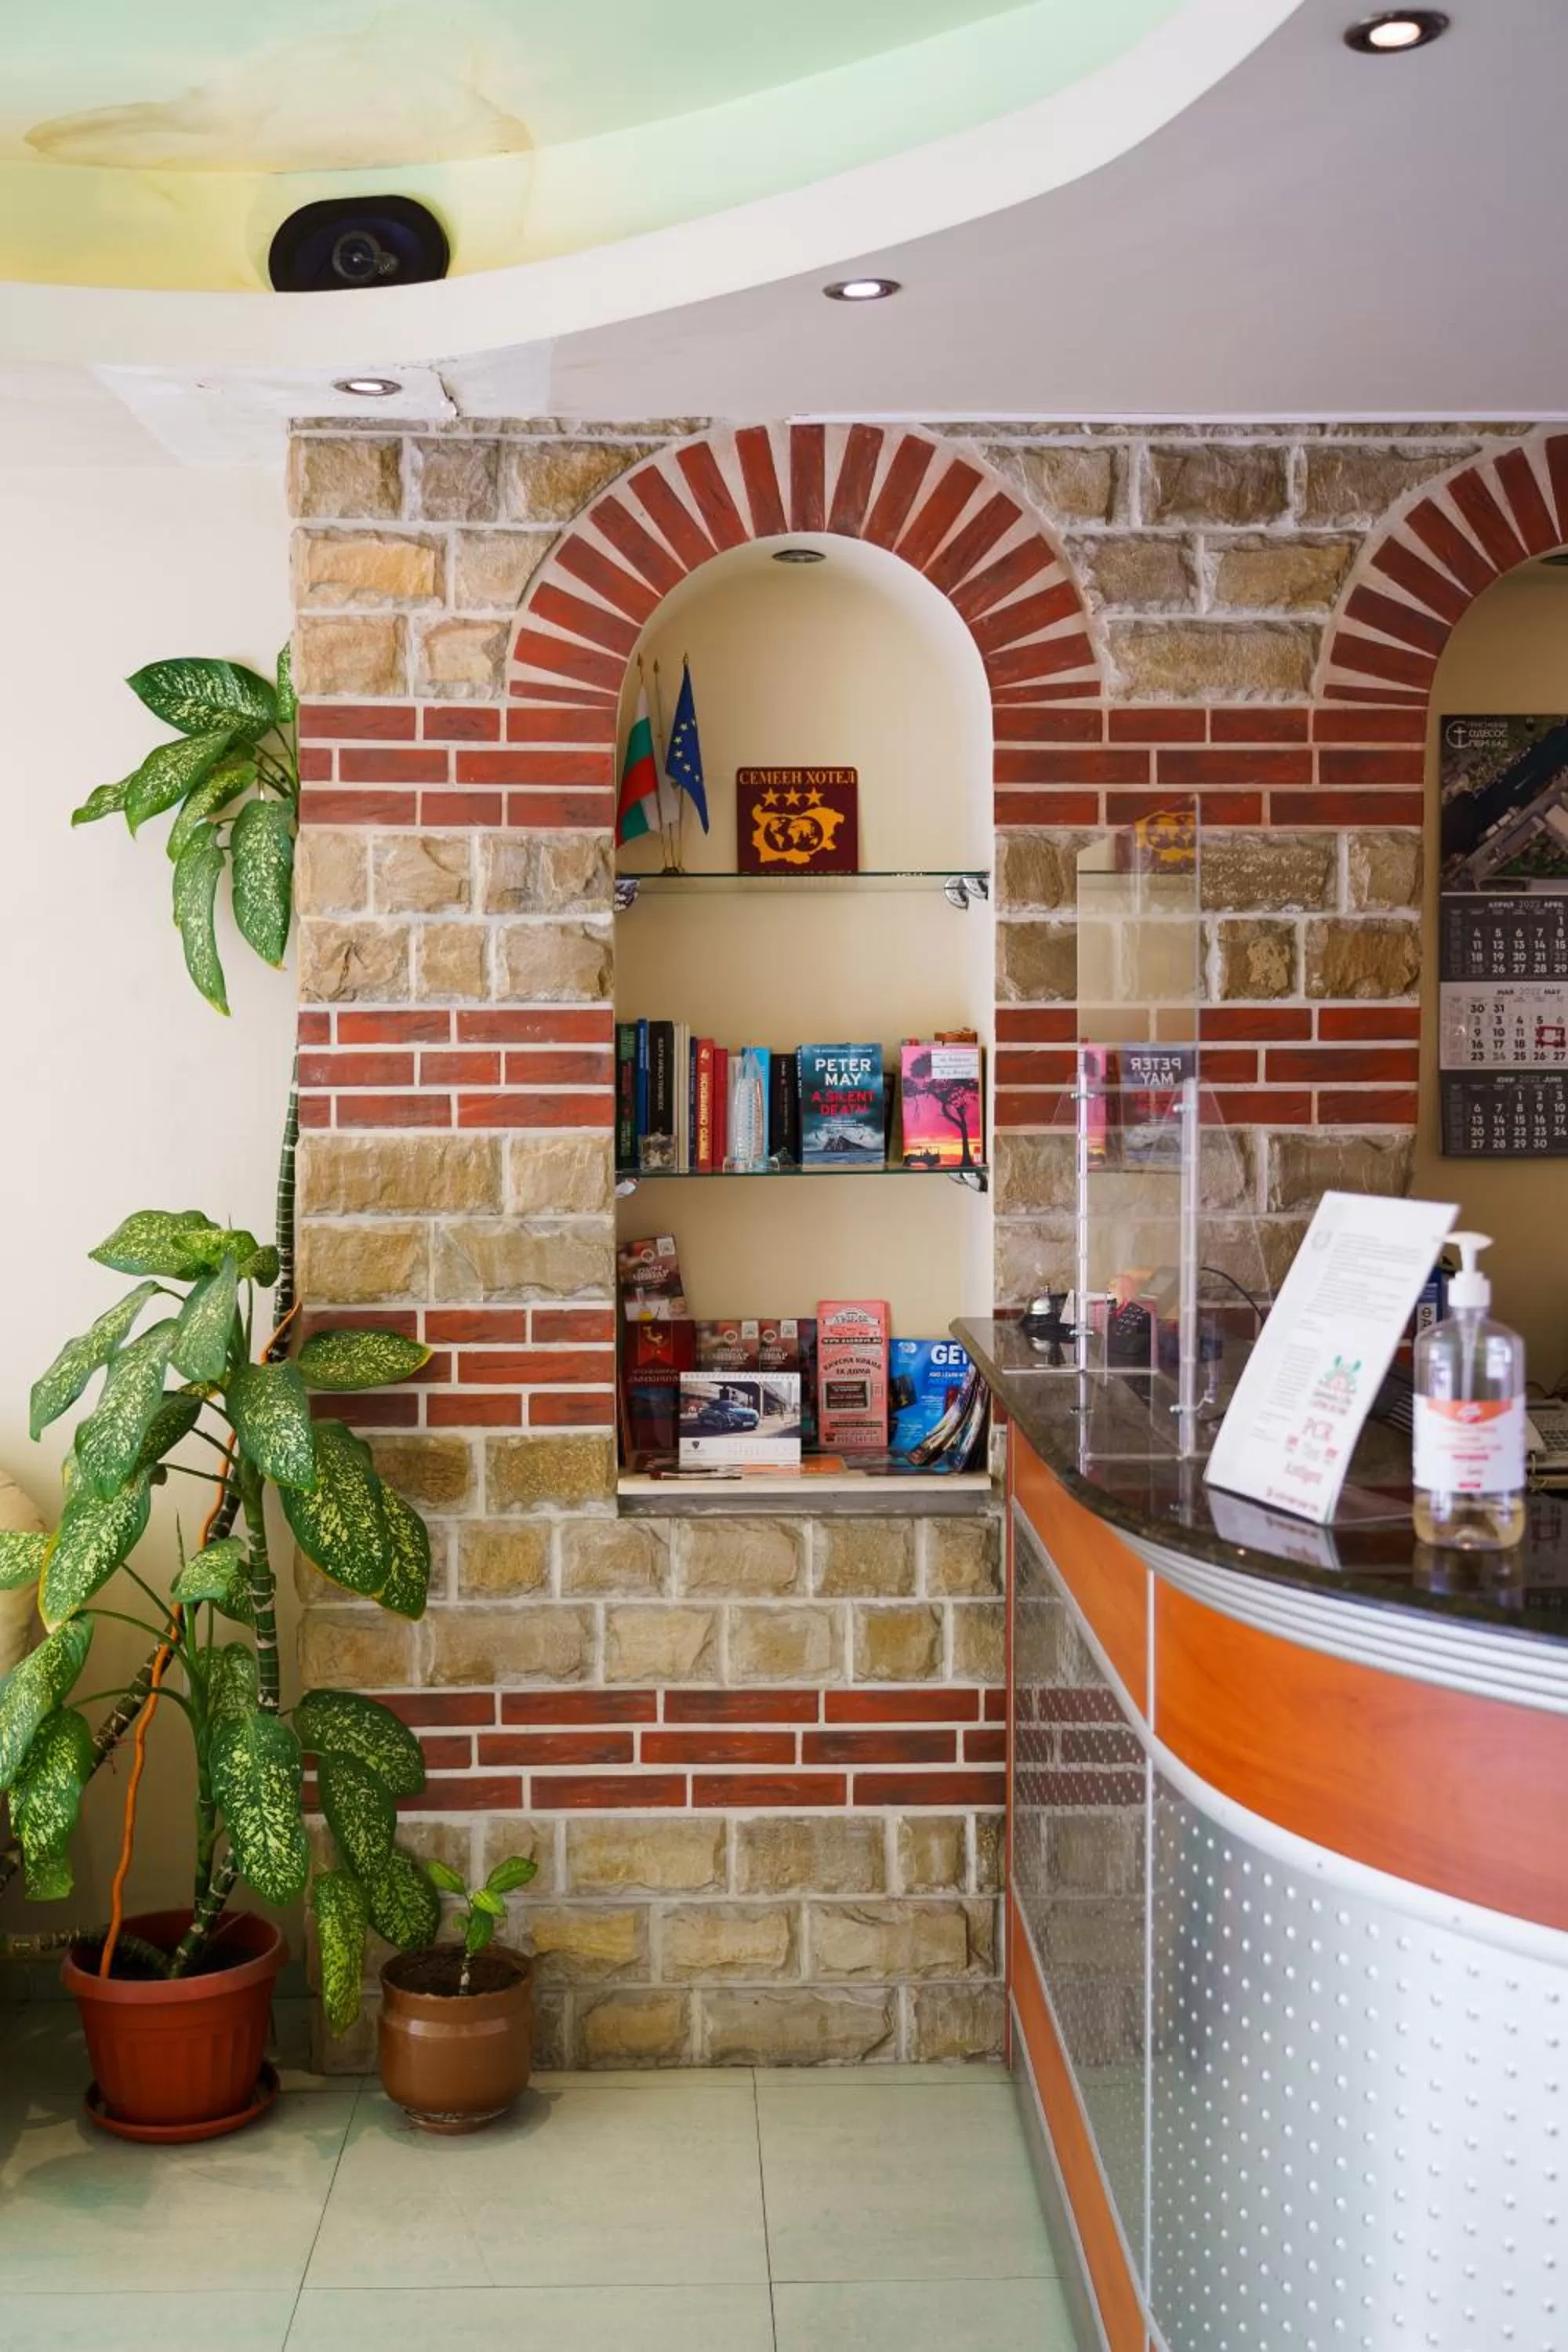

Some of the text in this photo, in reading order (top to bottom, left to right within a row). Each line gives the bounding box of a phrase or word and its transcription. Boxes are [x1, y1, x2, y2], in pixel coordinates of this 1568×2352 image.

[739, 771, 855, 784] СЕМЕЕН ХОТЕЛ
[1557, 916, 1563, 926] 1
[815, 1058, 871, 1072] PETER
[825, 1073, 862, 1086] MAY
[811, 1091, 874, 1102] A SILENT
[820, 1103, 869, 1116] DEATH
